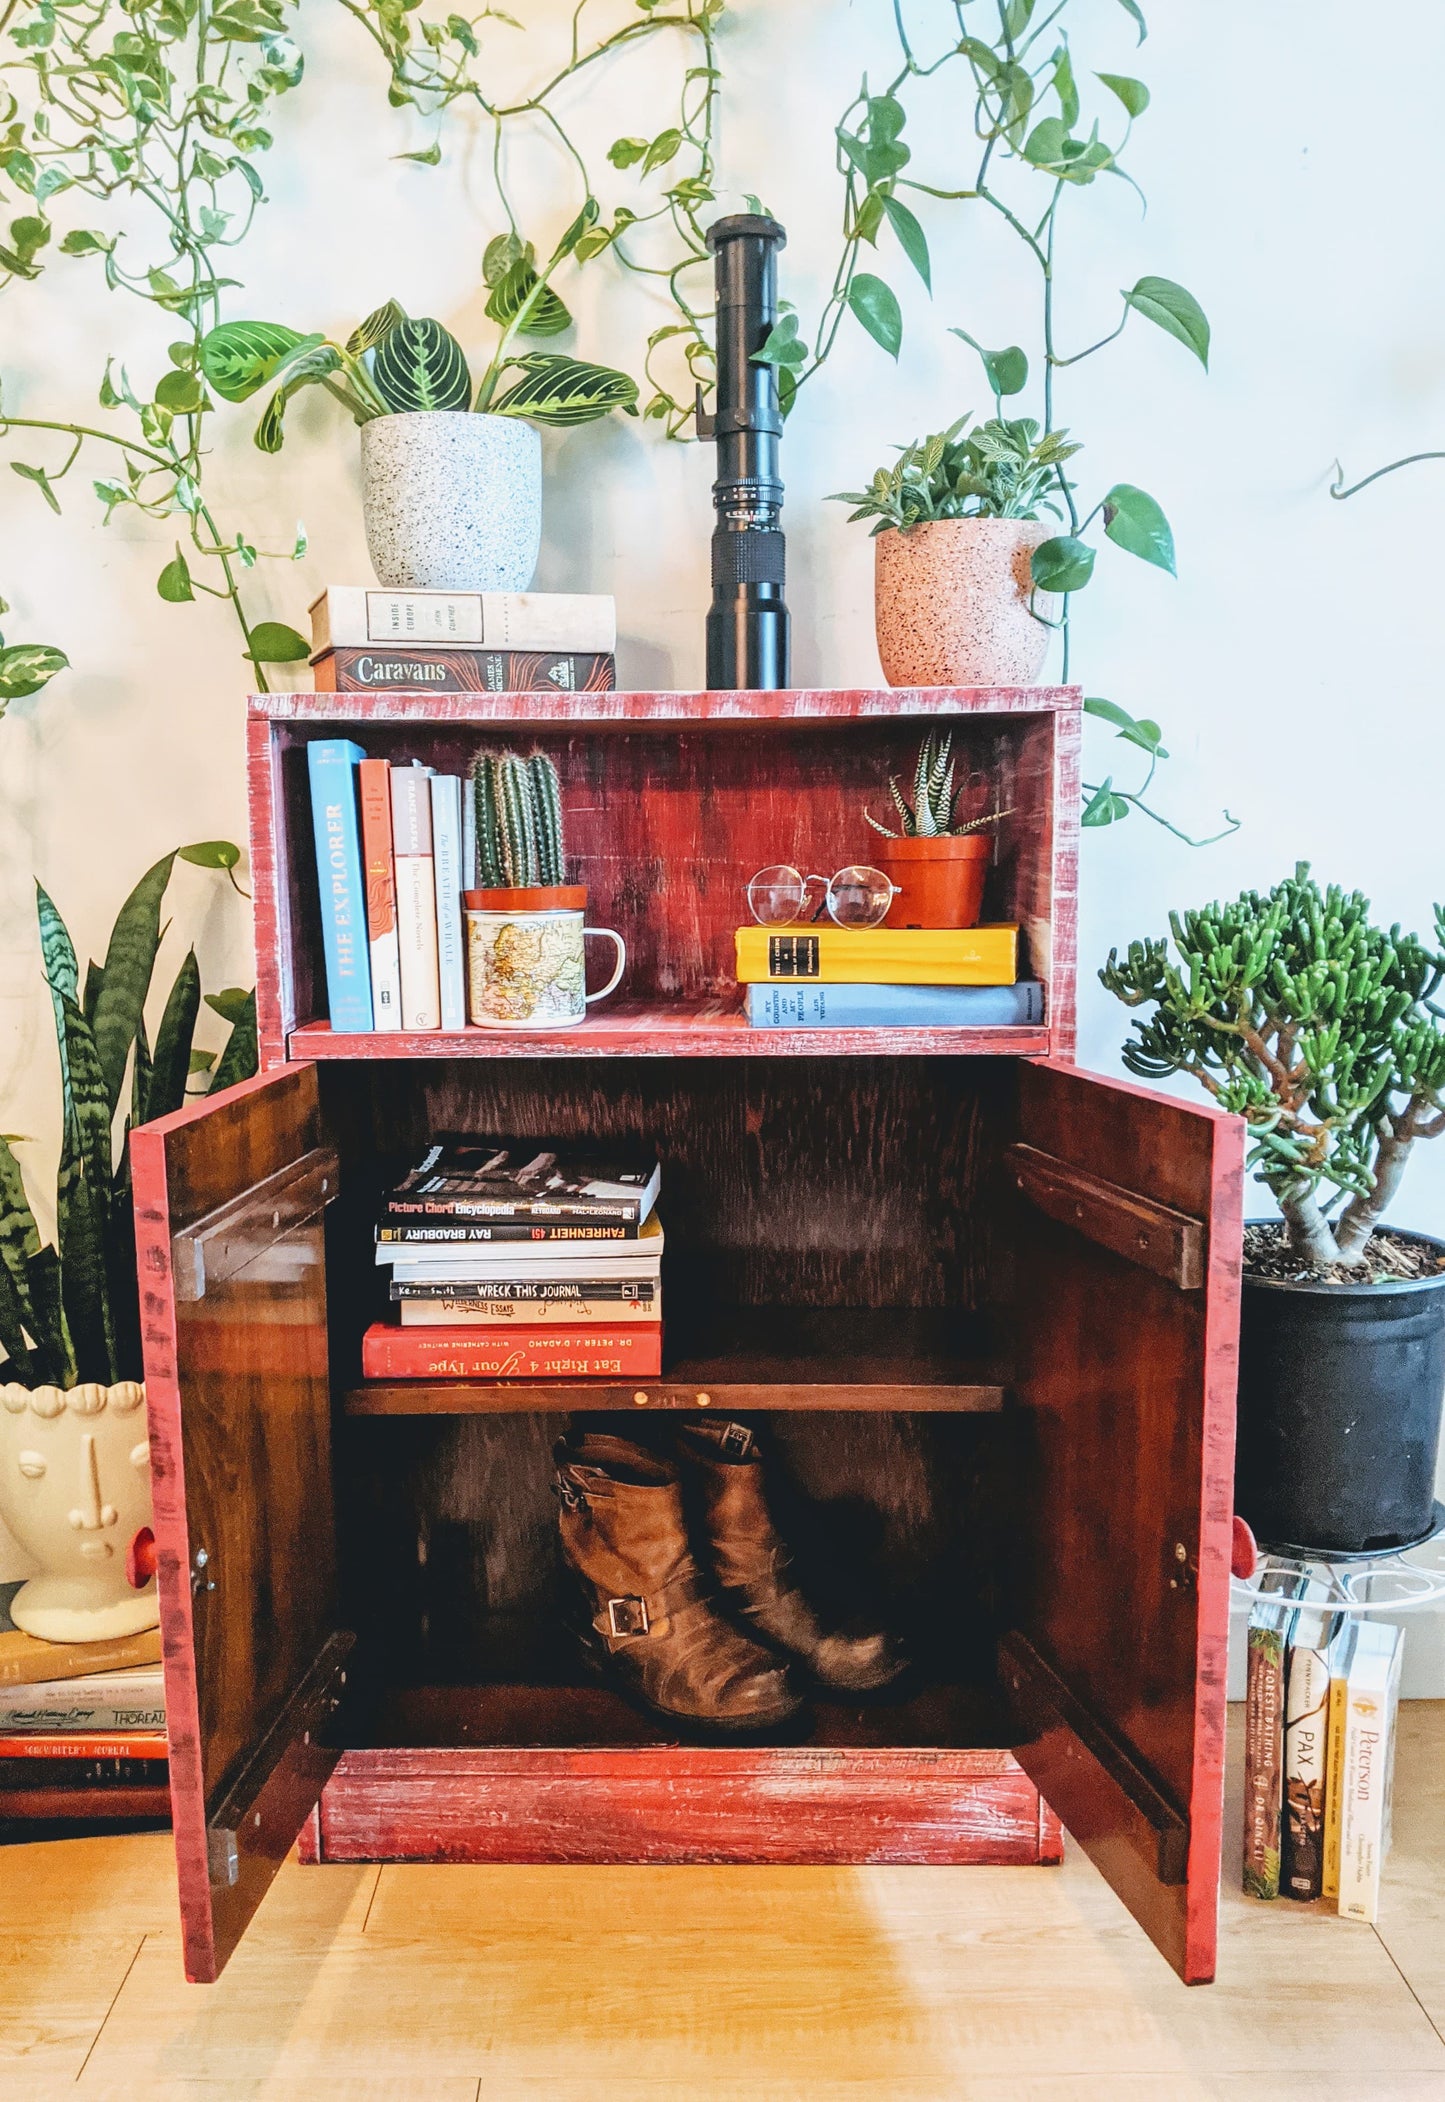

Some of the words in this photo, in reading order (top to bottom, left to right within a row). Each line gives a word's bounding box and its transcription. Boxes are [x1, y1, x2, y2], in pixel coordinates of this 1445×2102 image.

[391, 603, 400, 631] INSIDE
[406, 603, 415, 631] EUROPE
[357, 656, 446, 682] Caravans
[407, 780, 417, 814] FRANZ
[408, 815, 419, 850] KAFKA
[325, 803, 351, 926] EXPLORER
[441, 850, 452, 899] BREATH
[336, 932, 355, 977] THE
[444, 921, 454, 966] WHALE
[797, 990, 805, 1022] PEOPLE
[388, 1201, 423, 1214] Picture
[425, 1202, 454, 1214] Chord
[455, 1202, 515, 1217] Encyclopedia
[405, 1229, 467, 1240] BRADBURY
[468, 1229, 492, 1240] RAY
[531, 1228, 546, 1239] 451
[549, 1227, 626, 1239] FAHRENHEIT
[431, 1286, 455, 1295] Smith
[477, 1284, 512, 1298] WRECK
[513, 1284, 538, 1298] THIS
[540, 1285, 582, 1298] JOURNAL
[491, 1304, 515, 1315] ESSAYS
[528, 1340, 571, 1348] D'ADAMO
[584, 1339, 614, 1347] PETER
[429, 1359, 468, 1376] Type
[472, 1350, 526, 1376] Your
[530, 1360, 540, 1373] 4
[545, 1359, 589, 1373] Right
[594, 1359, 622, 1373] Eat
[1265, 1669, 1275, 1712] FOREST
[112, 1710, 166, 1726] THOREAU
[1264, 1717, 1274, 1767] BATHING
[1297, 1730, 1315, 1765] PAX
[1357, 1729, 1380, 1801] Peterson
[1254, 1817, 1265, 1846] QING
